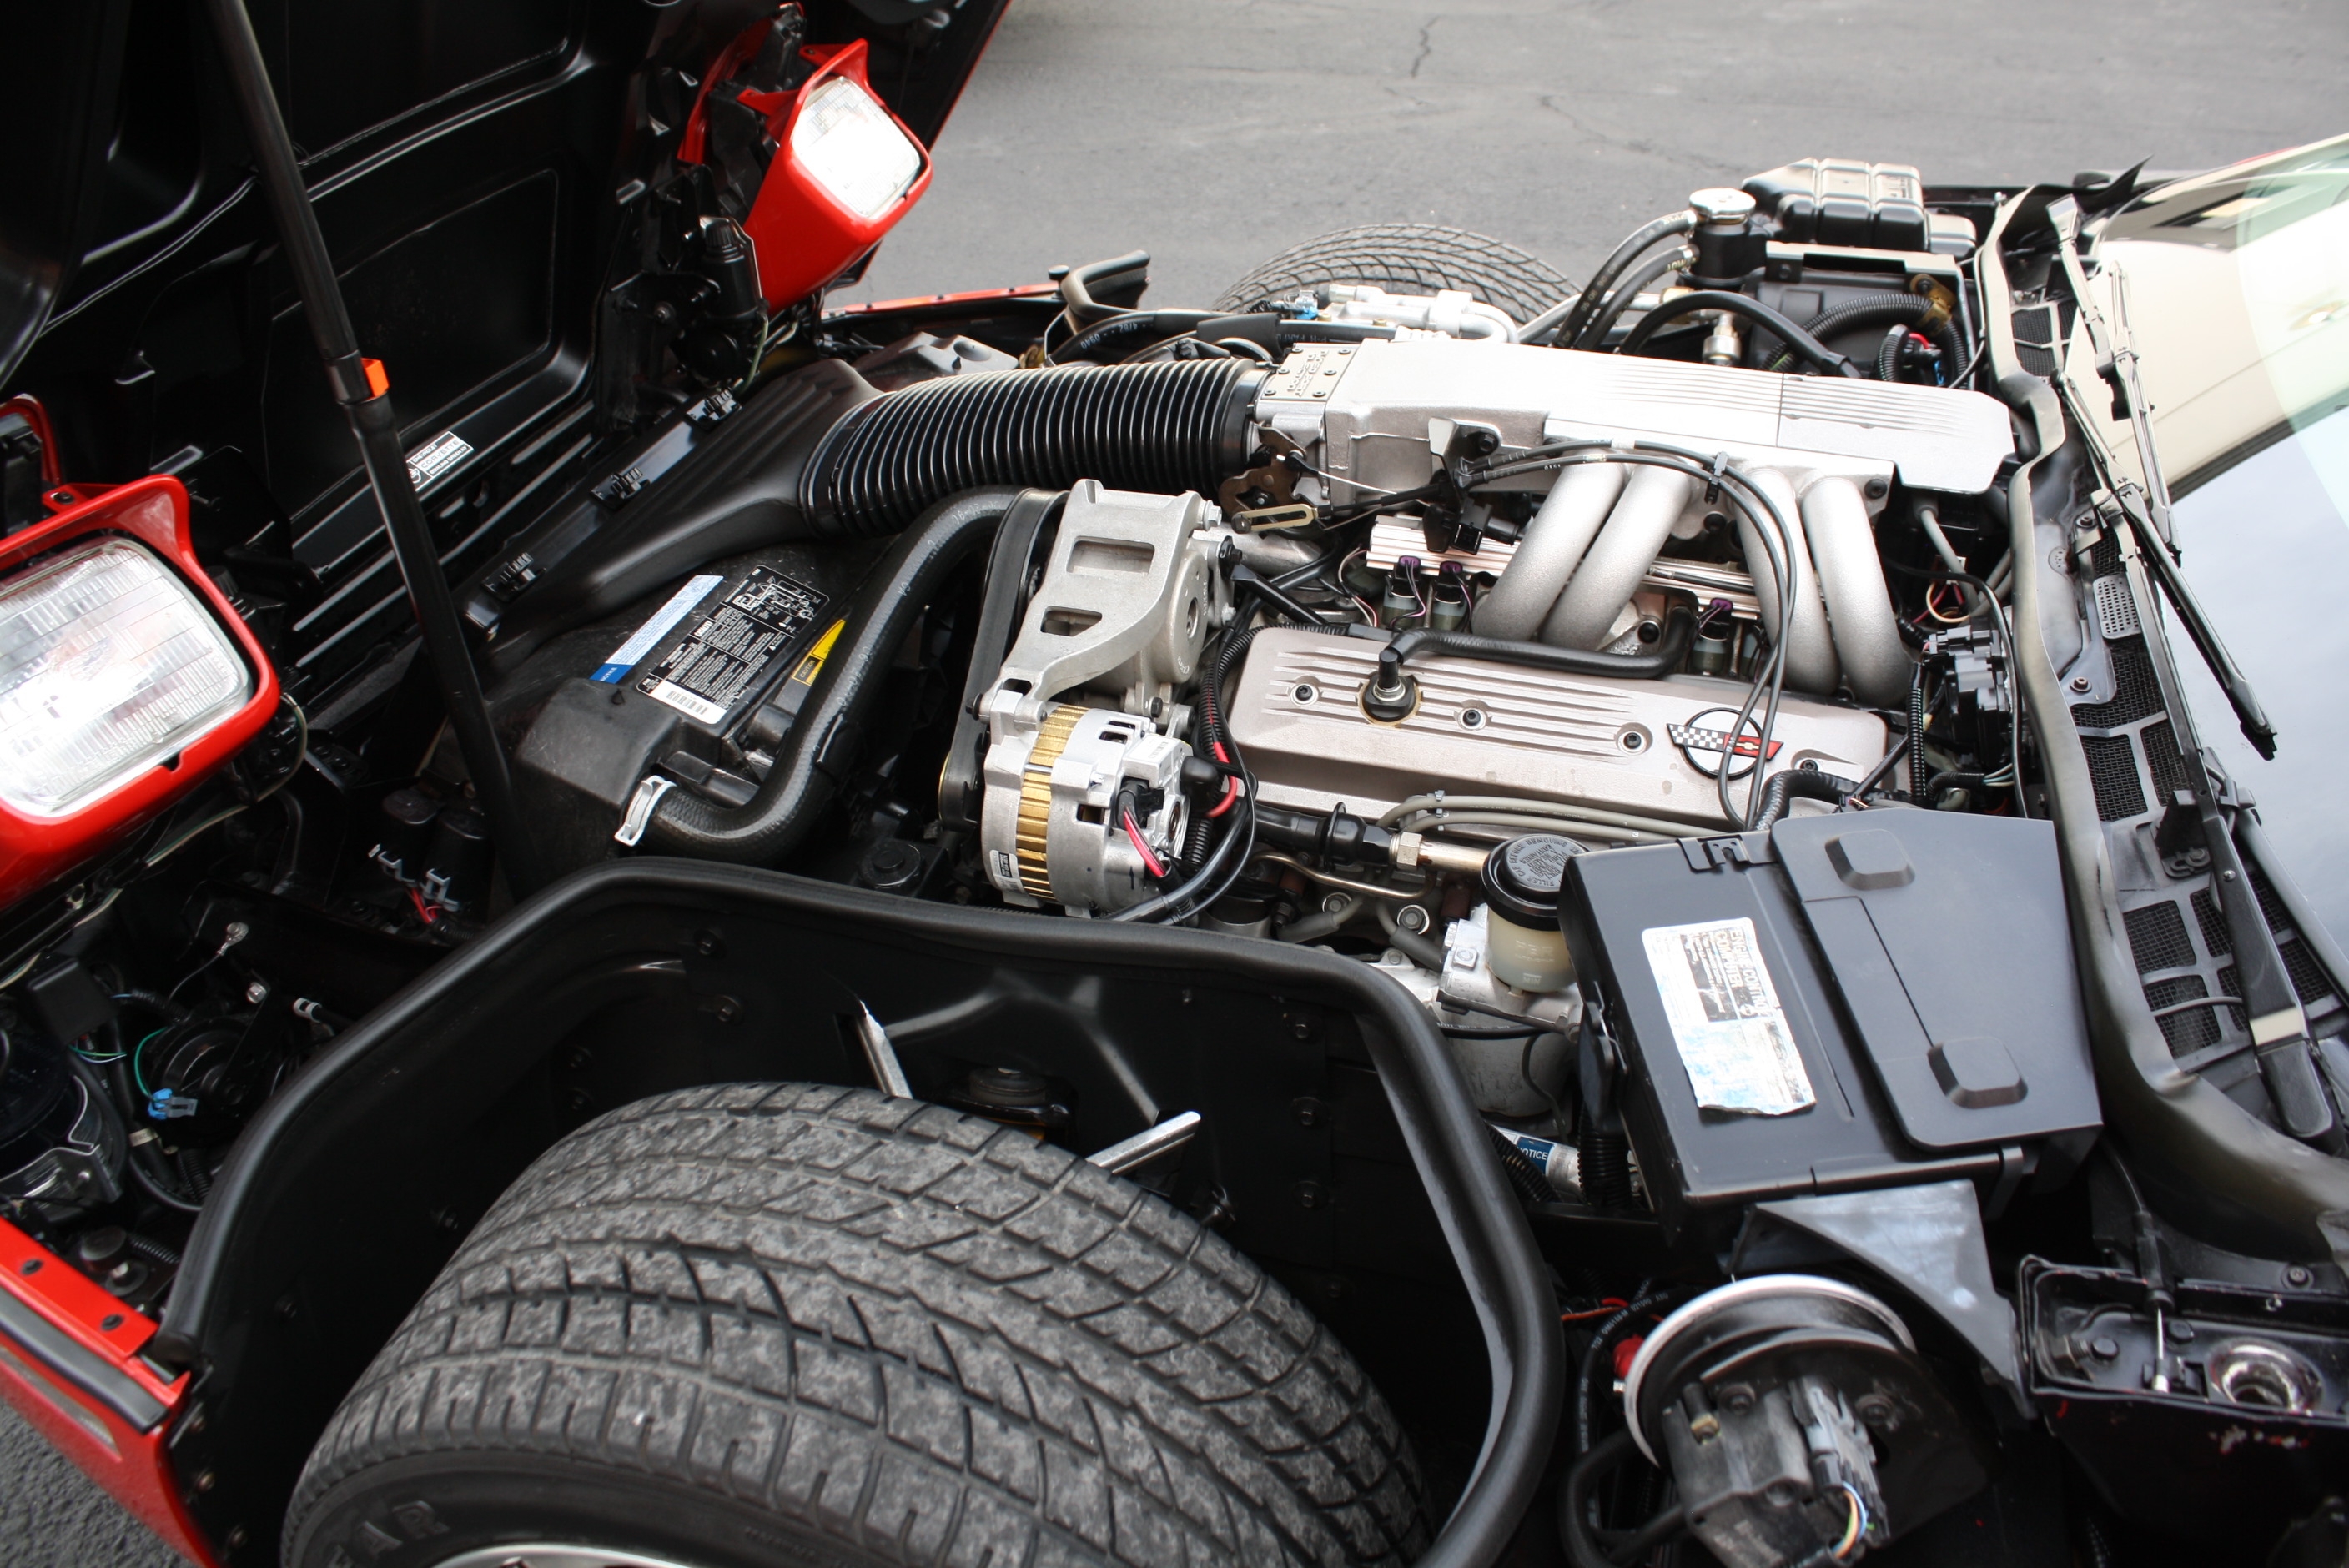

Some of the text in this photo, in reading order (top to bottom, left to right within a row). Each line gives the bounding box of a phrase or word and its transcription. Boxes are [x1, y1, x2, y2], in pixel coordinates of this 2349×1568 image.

[420, 440, 459, 468] CORVETTE
[799, 659, 816, 678] CAUTION
[1525, 837, 1568, 847] REMOVING
[1715, 931, 1743, 988] COMPUTER
[1730, 929, 1752, 969] ENGINE
